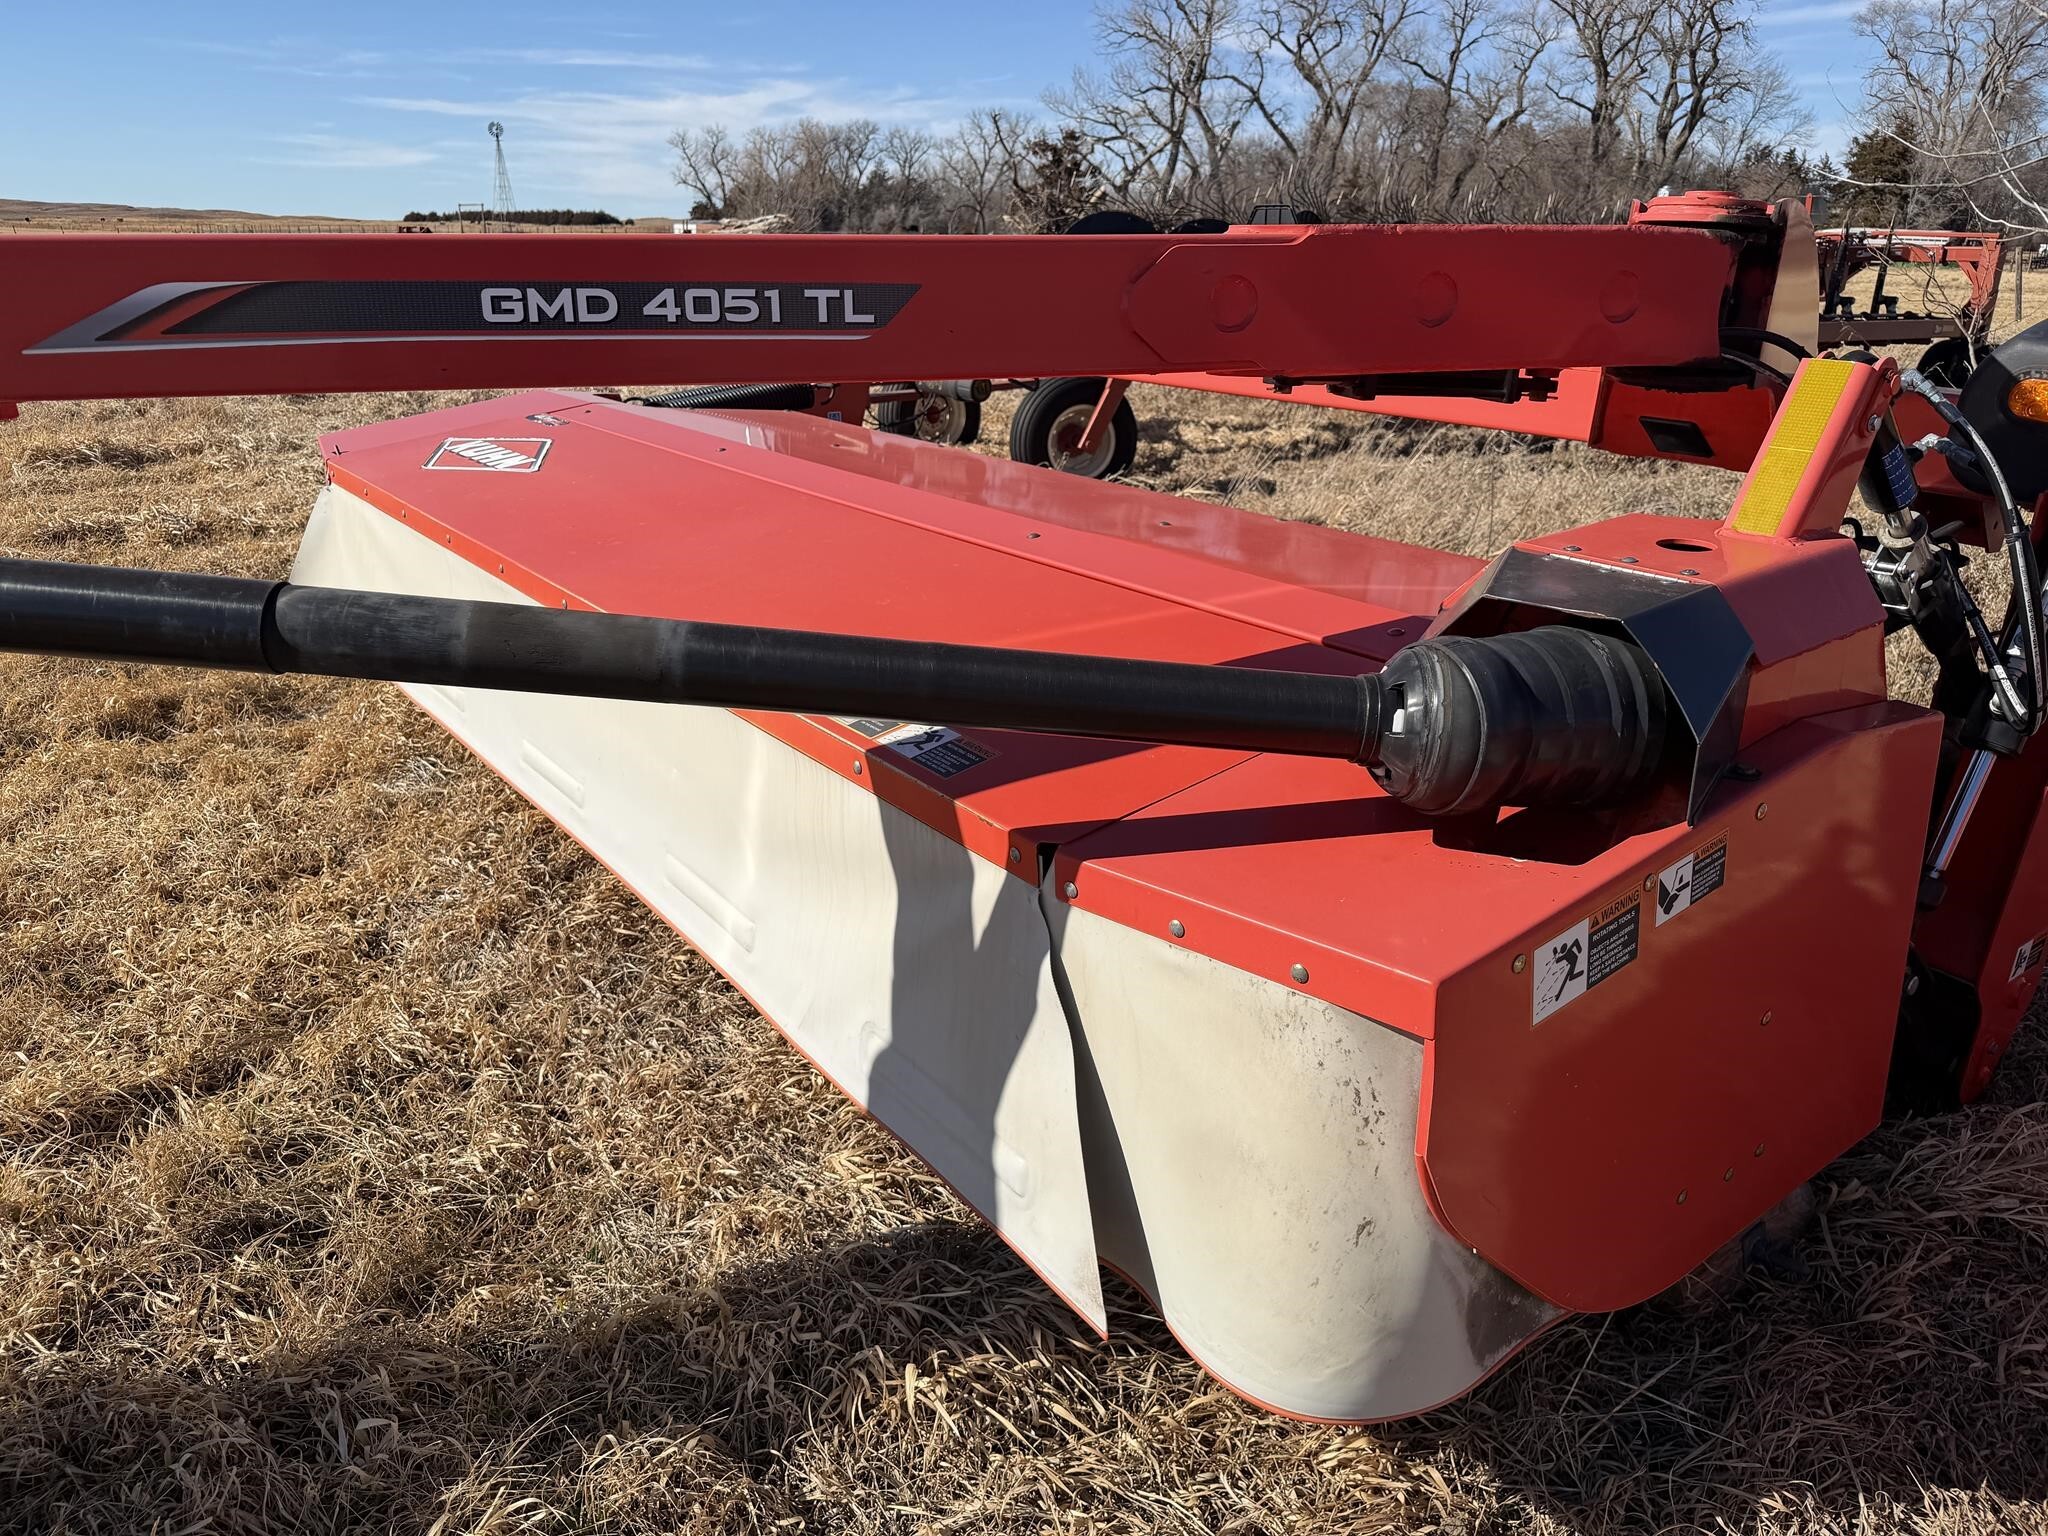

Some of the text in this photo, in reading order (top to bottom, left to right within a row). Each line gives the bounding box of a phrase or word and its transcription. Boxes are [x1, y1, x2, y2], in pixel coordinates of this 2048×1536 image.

[480, 288, 875, 323] GMD 4051 TL
[447, 440, 537, 469] KUHN
[1601, 889, 1639, 922] WARNING
[1592, 910, 1635, 942] ROTATING TOOLS
[1589, 951, 1599, 963] CAN
